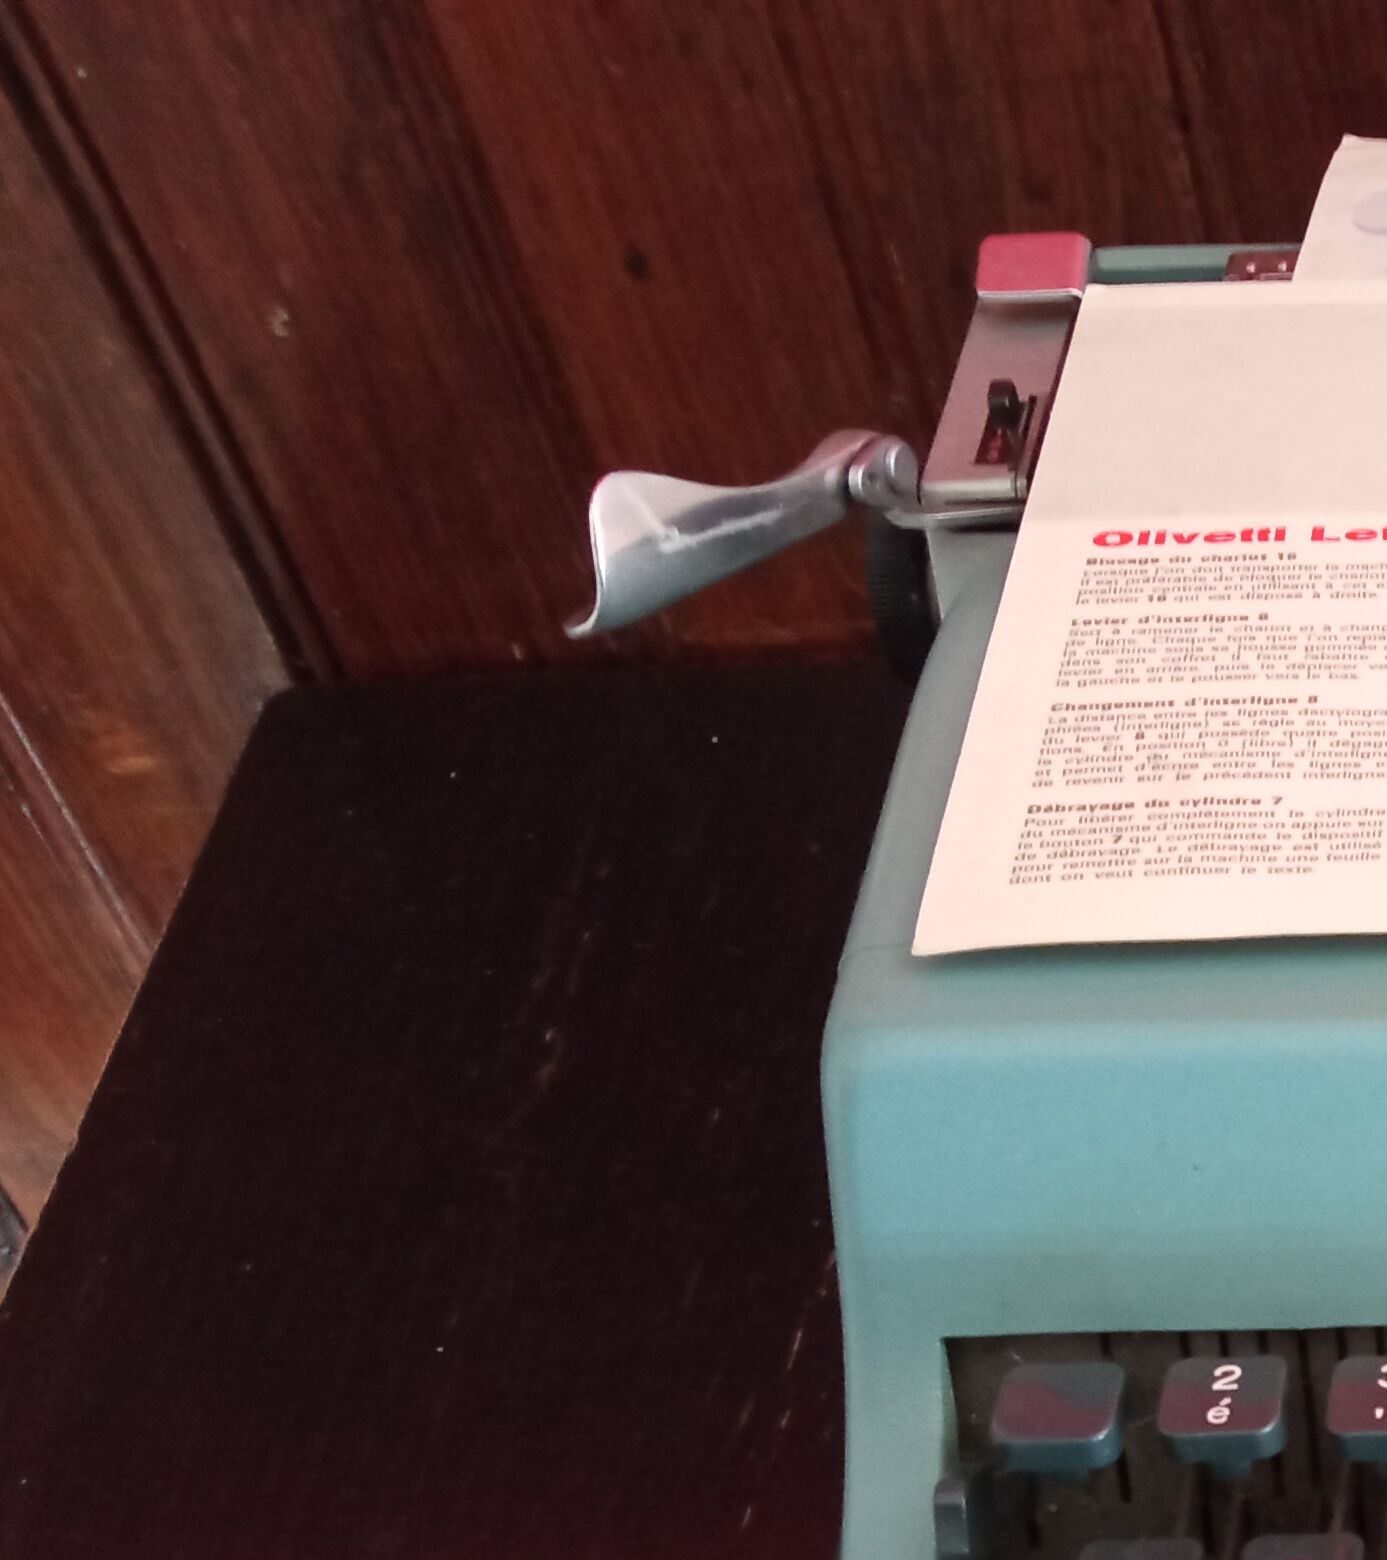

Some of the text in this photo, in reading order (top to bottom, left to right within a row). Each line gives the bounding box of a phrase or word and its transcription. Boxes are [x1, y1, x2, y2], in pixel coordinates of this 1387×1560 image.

[1092, 526, 1286, 547] Olivetti
[1050, 698, 1174, 712] Changement
[1184, 695, 1297, 708] d'interligne
[1027, 796, 1283, 814] Débrayage du cylindre 7
[1212, 1365, 1241, 1390] 2
[1207, 1398, 1231, 1423] é
